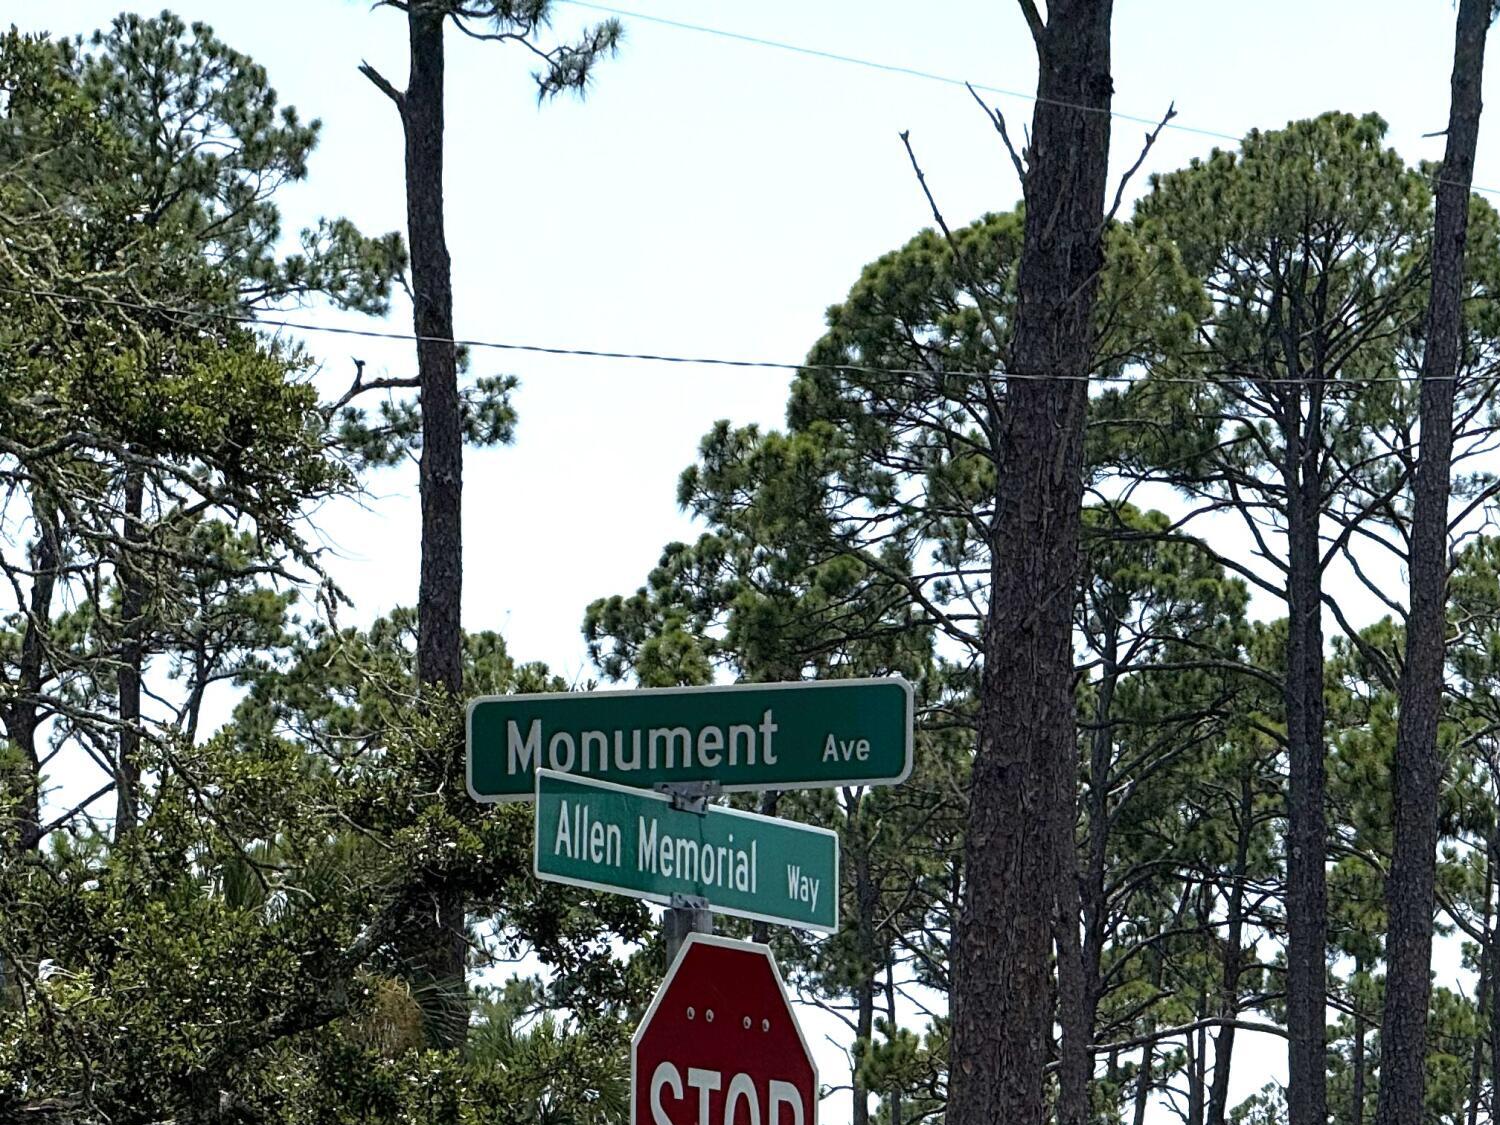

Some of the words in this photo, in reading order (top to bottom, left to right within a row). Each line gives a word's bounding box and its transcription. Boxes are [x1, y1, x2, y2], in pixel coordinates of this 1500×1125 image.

[506, 708, 778, 776] Monument
[822, 733, 871, 763] Ave
[554, 801, 622, 868] Allen
[637, 815, 757, 895] Memorial
[786, 863, 820, 913] Way
